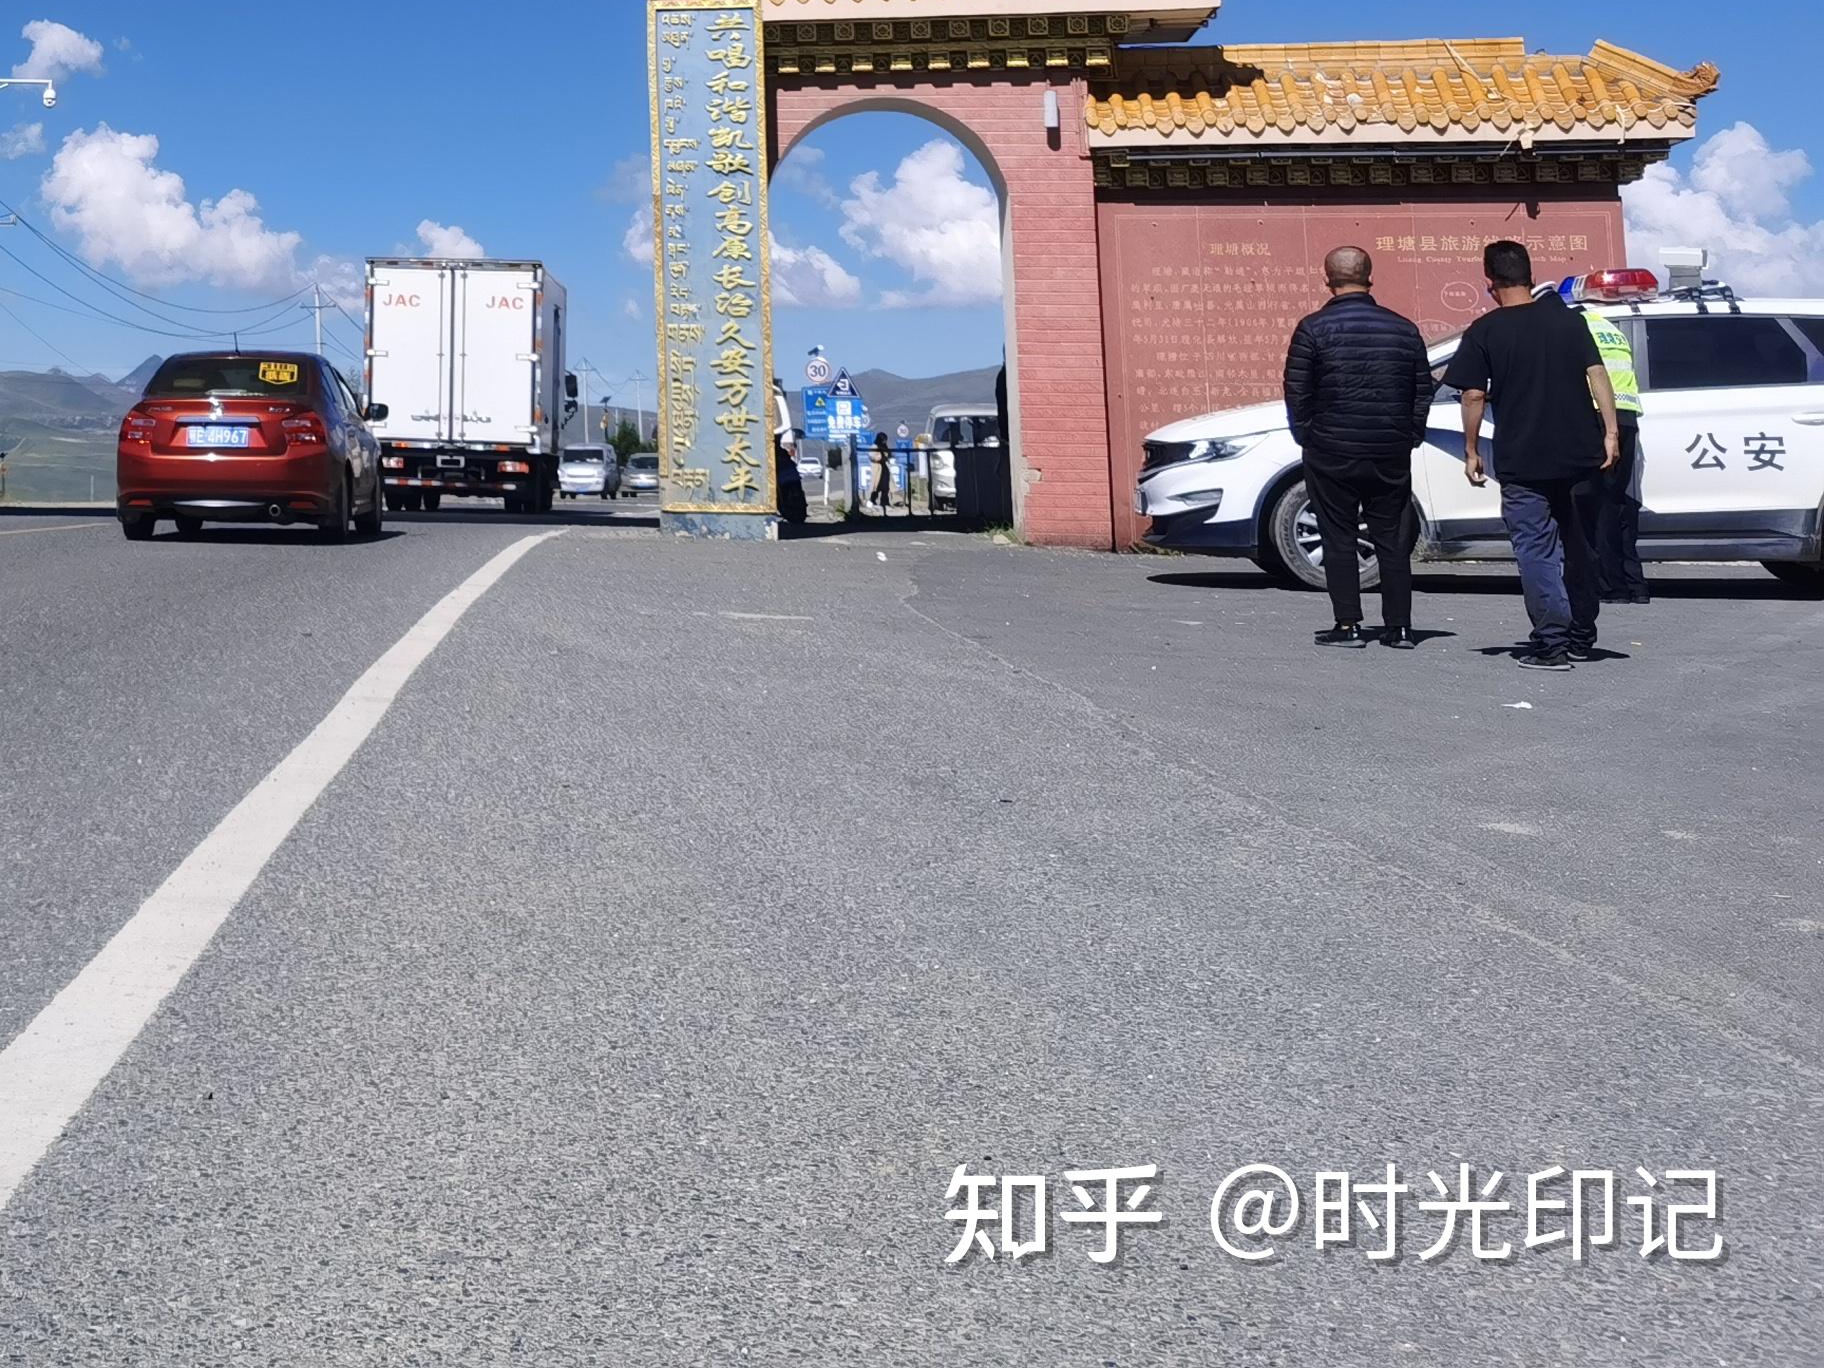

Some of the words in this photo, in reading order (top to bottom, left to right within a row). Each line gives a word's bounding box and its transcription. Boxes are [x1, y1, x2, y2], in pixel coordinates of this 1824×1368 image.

[704, 12, 760, 499] 共唱和谐凯歌创高原长治久安万世太平
[1209, 242, 1272, 257] 理塘概况
[382, 293, 421, 308] JAC
[485, 295, 525, 311] JAC
[810, 364, 826, 378] 30
[1685, 431, 1787, 472] 公安
